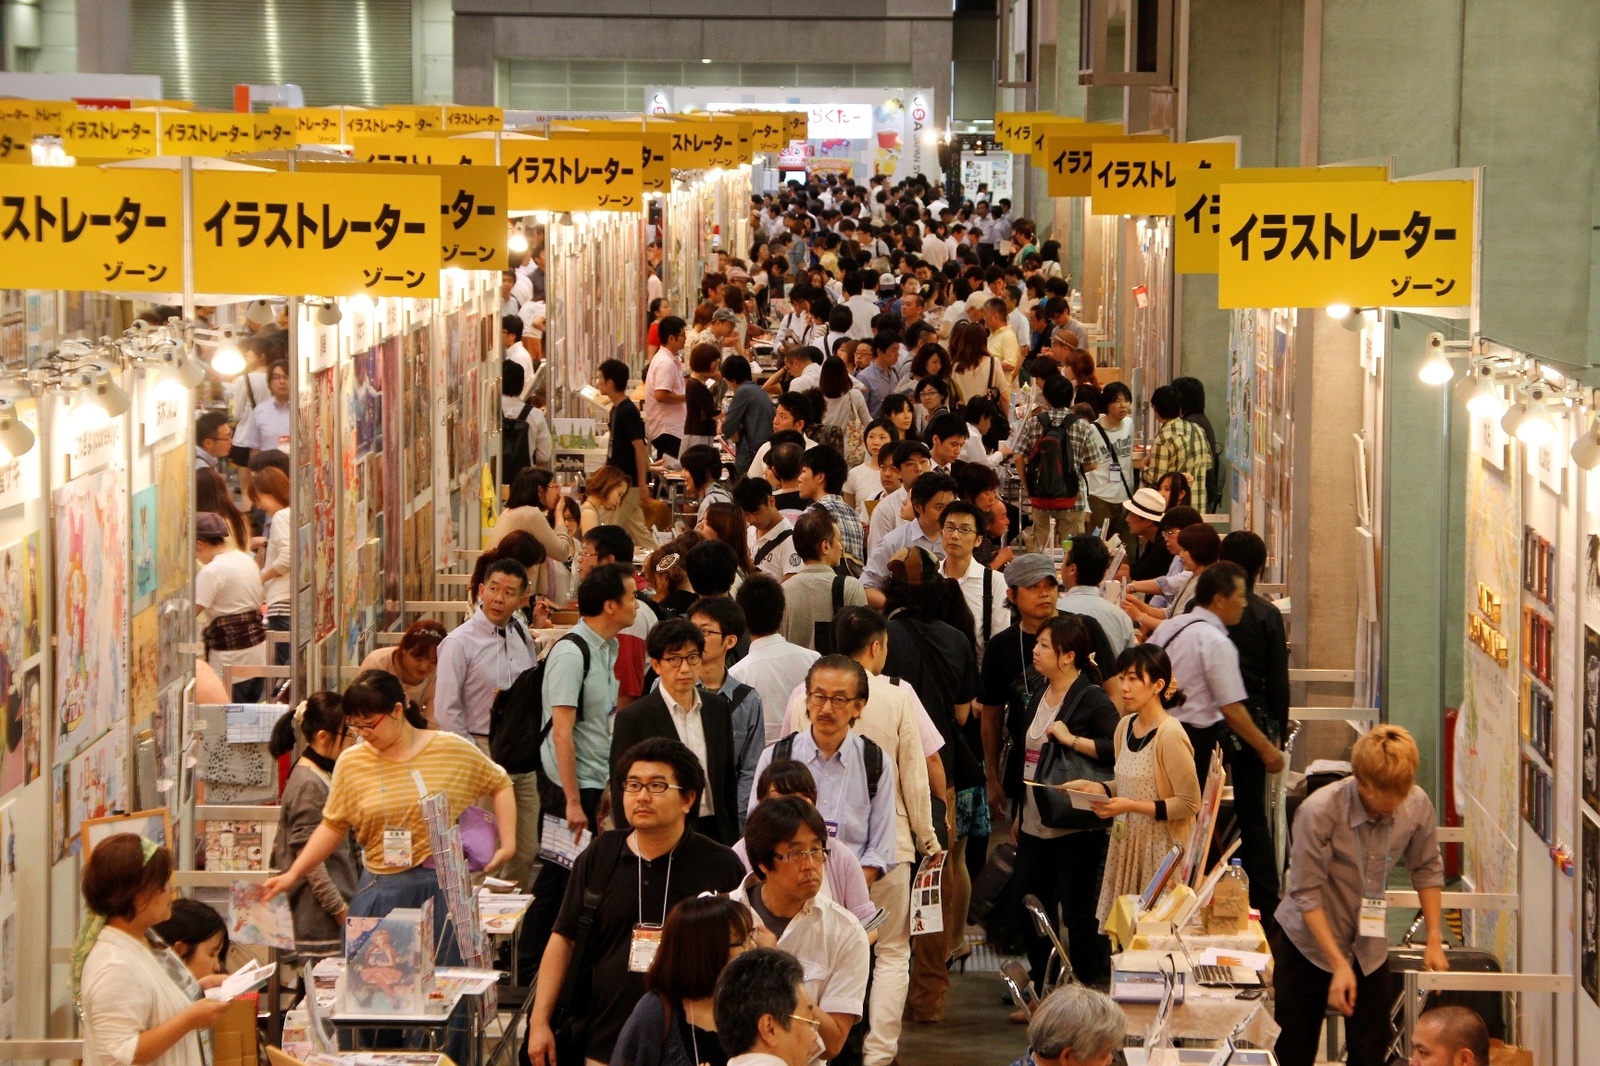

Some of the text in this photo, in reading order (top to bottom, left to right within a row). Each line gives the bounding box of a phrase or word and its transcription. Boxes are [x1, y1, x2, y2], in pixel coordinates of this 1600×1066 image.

[35, 108, 61, 121] トレー
[294, 116, 337, 130] トレーター
[447, 113, 500, 125] イラストレーター
[806, 109, 861, 123] らくたー
[65, 121, 151, 140] イラストレーター
[164, 123, 249, 142] イラストレーター
[254, 123, 292, 141] レーター
[347, 118, 411, 133] イラストレーター
[672, 133, 733, 152] ストレーター
[507, 155, 634, 185] イラストレーター
[597, 194, 634, 208] ゾーン
[1, 195, 167, 244] ストレーター
[203, 199, 426, 251] イラストレーター
[1229, 209, 1457, 262] イラストレーター
[442, 243, 496, 263] ゾーン
[104, 261, 168, 283] ゾーン
[362, 267, 426, 289] ゾーン
[1390, 275, 1456, 298] ゾーン
